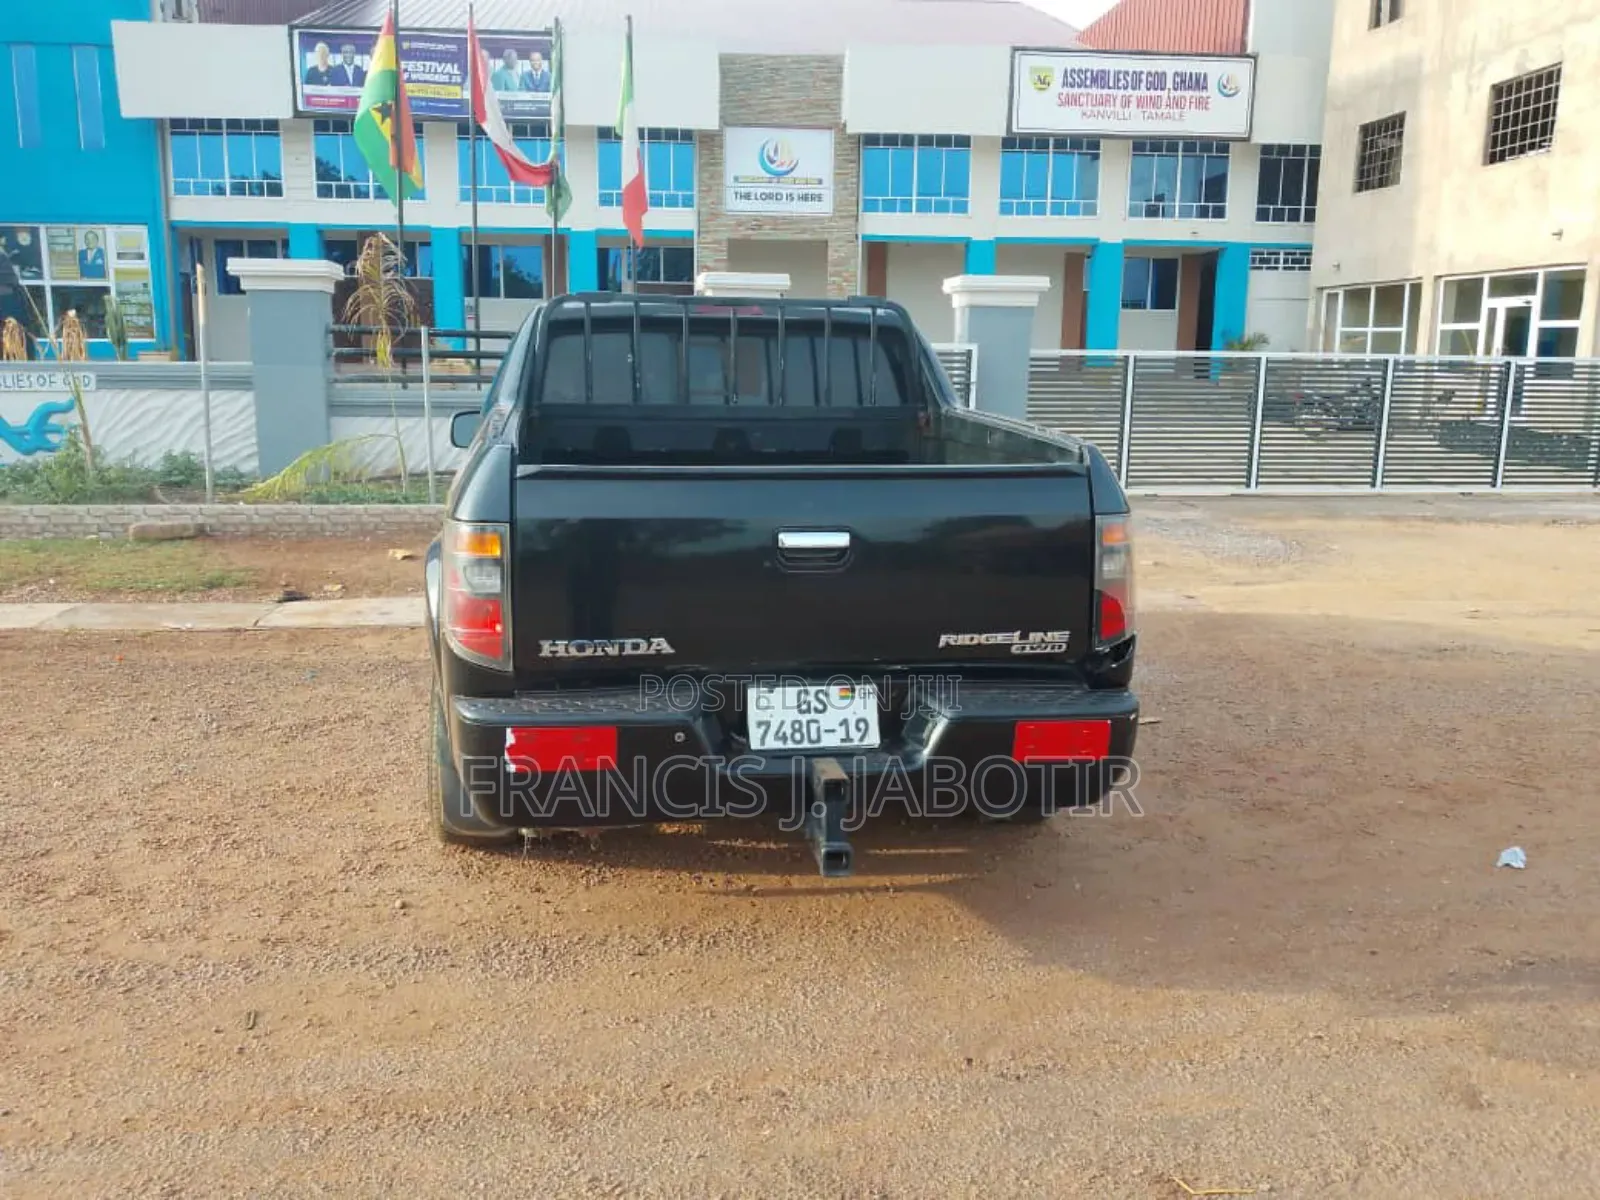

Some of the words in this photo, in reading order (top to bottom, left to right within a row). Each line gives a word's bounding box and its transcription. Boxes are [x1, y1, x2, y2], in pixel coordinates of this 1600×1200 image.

[401, 61, 461, 75] FESTIVAL
[1061, 67, 1130, 90] ASSEMBLIES
[1130, 70, 1144, 91] OF
[1172, 71, 1209, 92] GHANA
[1057, 92, 1117, 108] SANCTUARY
[1120, 94, 1133, 109] OF
[1136, 94, 1162, 110] WIND
[1165, 95, 1187, 111] AND
[1188, 96, 1211, 111] FIRE
[1081, 109, 1132, 121] KANVILLI
[1141, 111, 1187, 122] TAMALE
[734, 191, 752, 201] THE
[754, 192, 784, 202] LORD
[785, 193, 795, 202] IS
[797, 193, 824, 202] HERE
[0, 373, 33, 388] LIES
[36, 374, 57, 388] OF
[538, 637, 675, 657] HONDA
[938, 630, 1071, 648] RIDGELINE
[796, 688, 829, 714] GS
[756, 717, 870, 746] 7480-19
